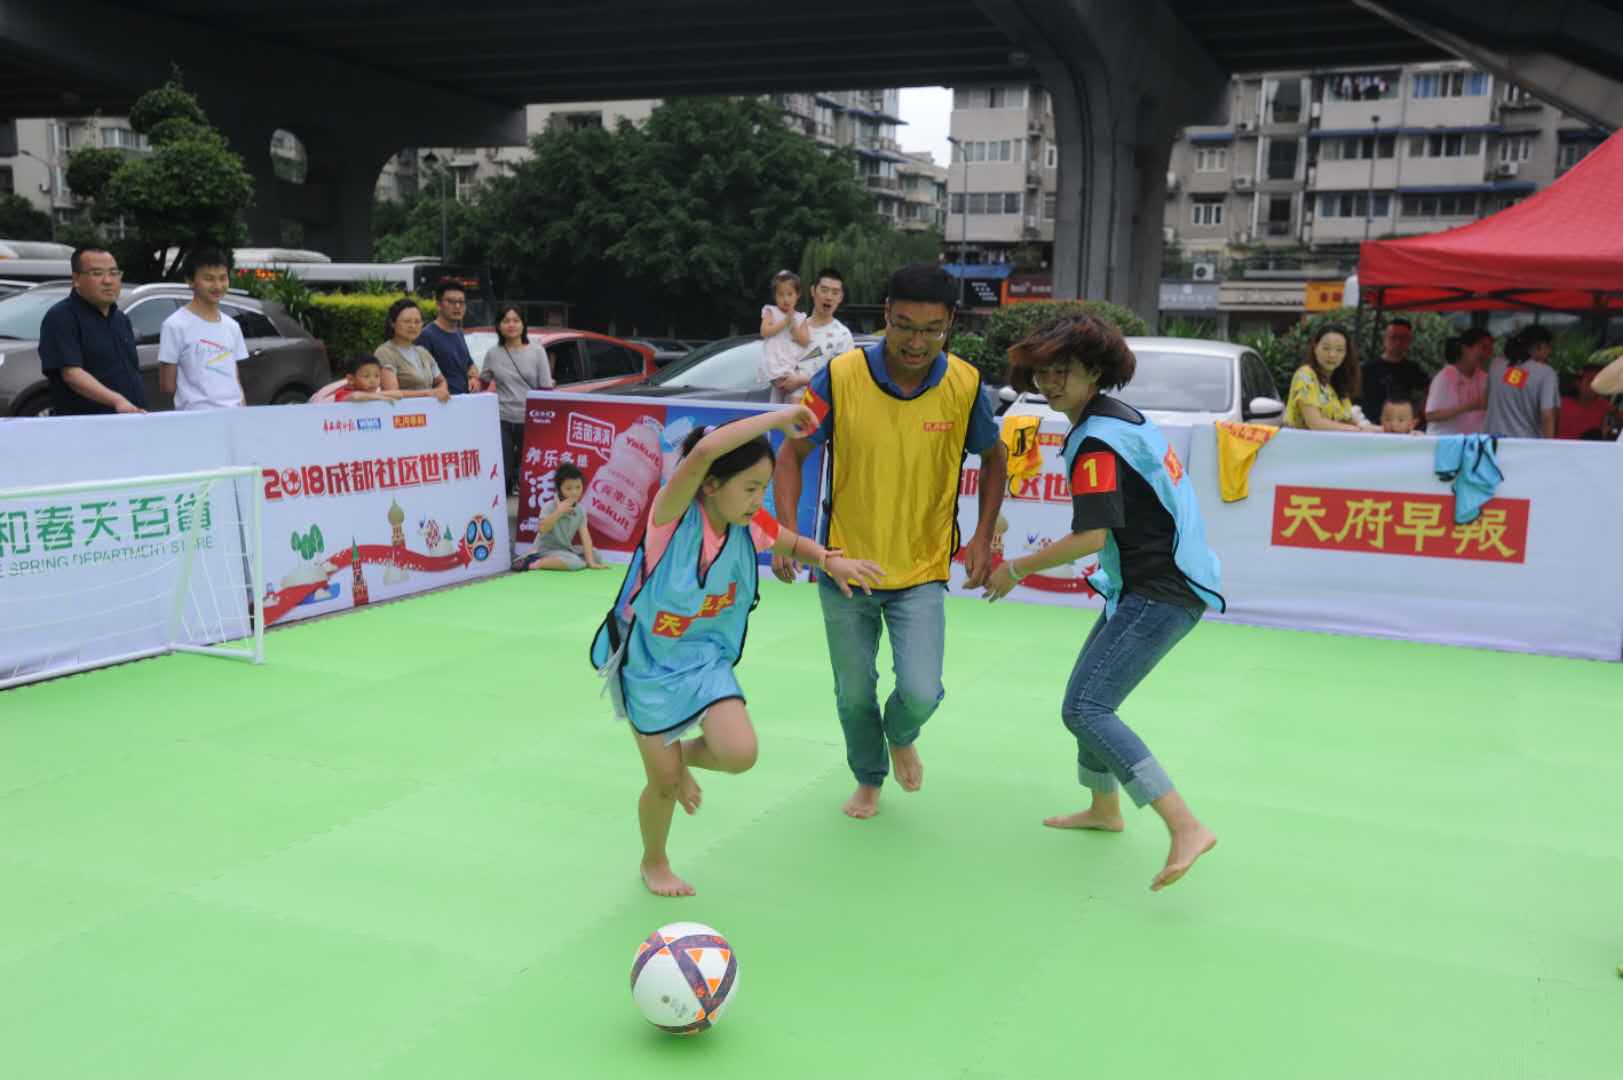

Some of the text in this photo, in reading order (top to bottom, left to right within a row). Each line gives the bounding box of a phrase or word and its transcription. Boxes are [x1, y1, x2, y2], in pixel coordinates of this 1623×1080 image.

[626, 436, 660, 467] Yakult
[261, 448, 481, 500] 2018成都社区世界杯
[1082, 458, 1098, 488] 1
[592, 496, 630, 529] Yakult
[8, 556, 70, 577] SPRING
[72, 542, 166, 567] DEPARTMENT
[170, 535, 214, 553] STRE
